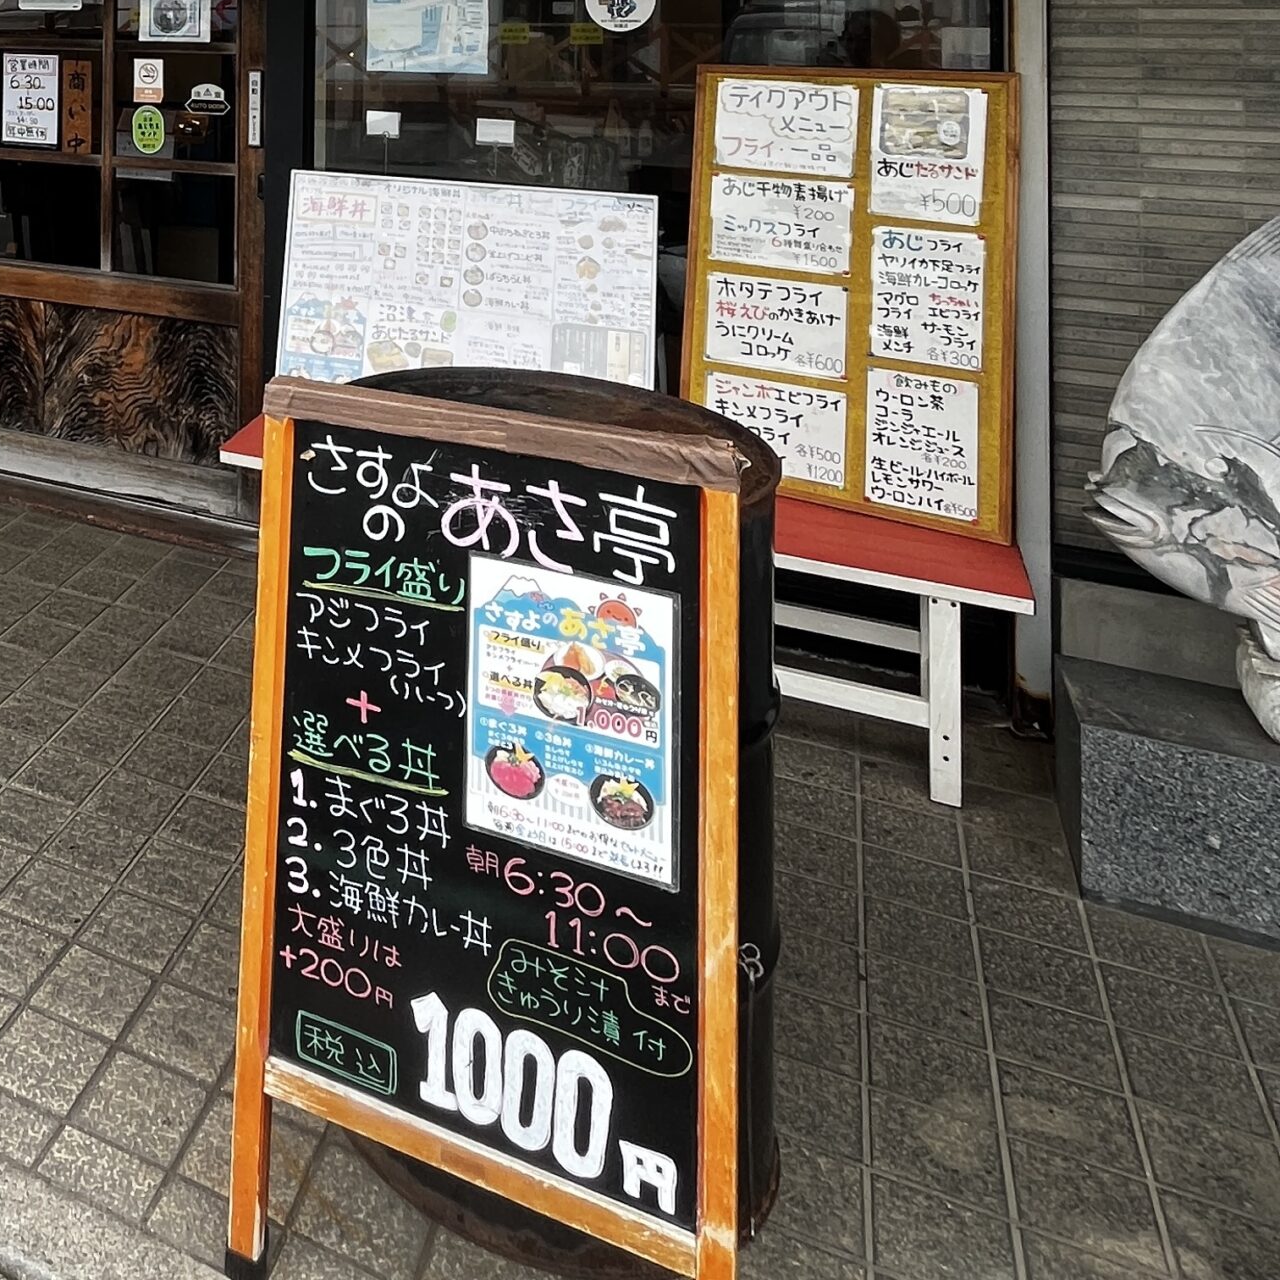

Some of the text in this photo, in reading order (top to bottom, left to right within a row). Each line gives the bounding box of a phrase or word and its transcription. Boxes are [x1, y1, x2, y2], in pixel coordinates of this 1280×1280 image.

[779, 116, 846, 133] メニュー
[877, 158, 979, 181] あじたるサンド
[722, 177, 849, 203] あじ干物素揚げ
[920, 188, 977, 218] ¥500
[792, 204, 836, 222] ¥200
[723, 214, 821, 239] ミックスフライ
[881, 230, 963, 253] あじフライ
[877, 253, 981, 275] ヤリイカ下足フライ
[716, 277, 823, 307] ホタテフライ
[878, 271, 979, 293] 海鮮カレーコロッケ
[877, 291, 919, 306] マグロ
[877, 307, 912, 320] フライ
[928, 307, 981, 321] エビフライ
[715, 321, 794, 346] うにクリーム
[877, 323, 909, 339] 海鮮
[920, 321, 969, 337] サーモン
[740, 341, 792, 361] コロッケ
[882, 339, 915, 354] メンチ
[939, 335, 977, 351] フライ
[715, 379, 842, 412] ジャンボエビフライ
[893, 373, 958, 395] 飲みもの
[875, 387, 945, 412] ウーロン茶
[714, 398, 804, 429] キンメフライ
[875, 404, 914, 422] コーラ
[874, 418, 961, 443] ジンジャエール
[872, 431, 966, 459] オレンジジュース
[871, 471, 945, 492] レモンサワー
[306, 435, 677, 586] さすよ あさ亭
[870, 485, 945, 512] ウーロンハイ
[362, 505, 406, 543] の
[303, 546, 467, 605] フライ盛り
[295, 592, 431, 647] アジフライ
[484, 601, 647, 656] さすよのあさ亭
[490, 630, 542, 651] フライ盛り
[295, 626, 448, 685] キンメフライ
[489, 671, 533, 690] 選べる丼
[293, 710, 441, 793] 選べる丼
[289, 771, 452, 850] 1. まぐろ丼
[285, 818, 434, 890] 2. 3色丼
[285, 856, 493, 956] 3. 海鮮カレー丼
[287, 901, 403, 969] 大盛りは
[543, 910, 681, 985] 11:00
[279, 948, 395, 1010] +200円
[509, 946, 611, 1003] みそ汁
[652, 984, 692, 1016] まで
[494, 972, 668, 1063] きゅうり漬 付
[303, 1021, 387, 1085] 税込
